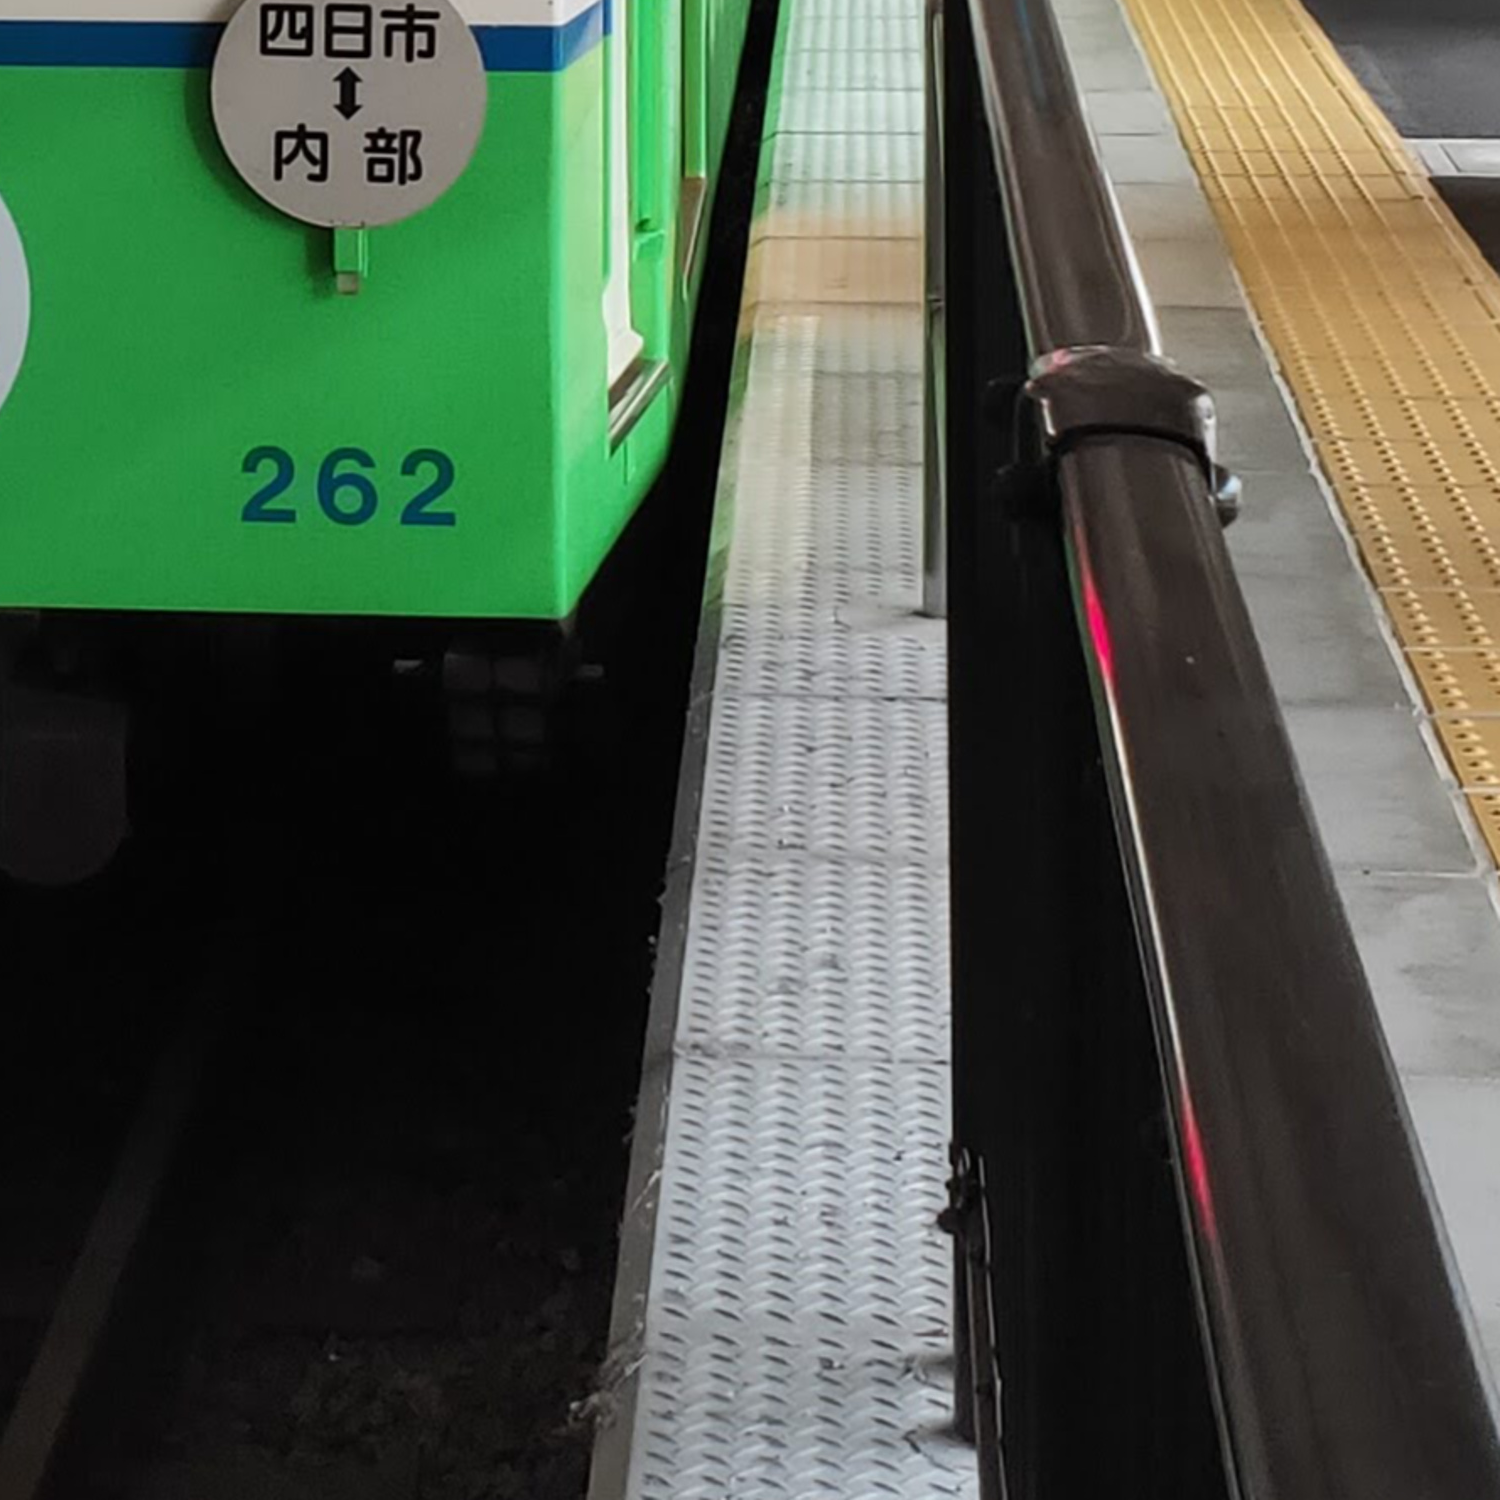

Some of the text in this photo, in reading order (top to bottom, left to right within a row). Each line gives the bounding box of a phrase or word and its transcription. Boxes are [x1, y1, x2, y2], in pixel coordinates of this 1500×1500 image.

[259, 2, 441, 64] 四日市
[272, 122, 424, 186] 内部
[239, 444, 458, 528] 262
